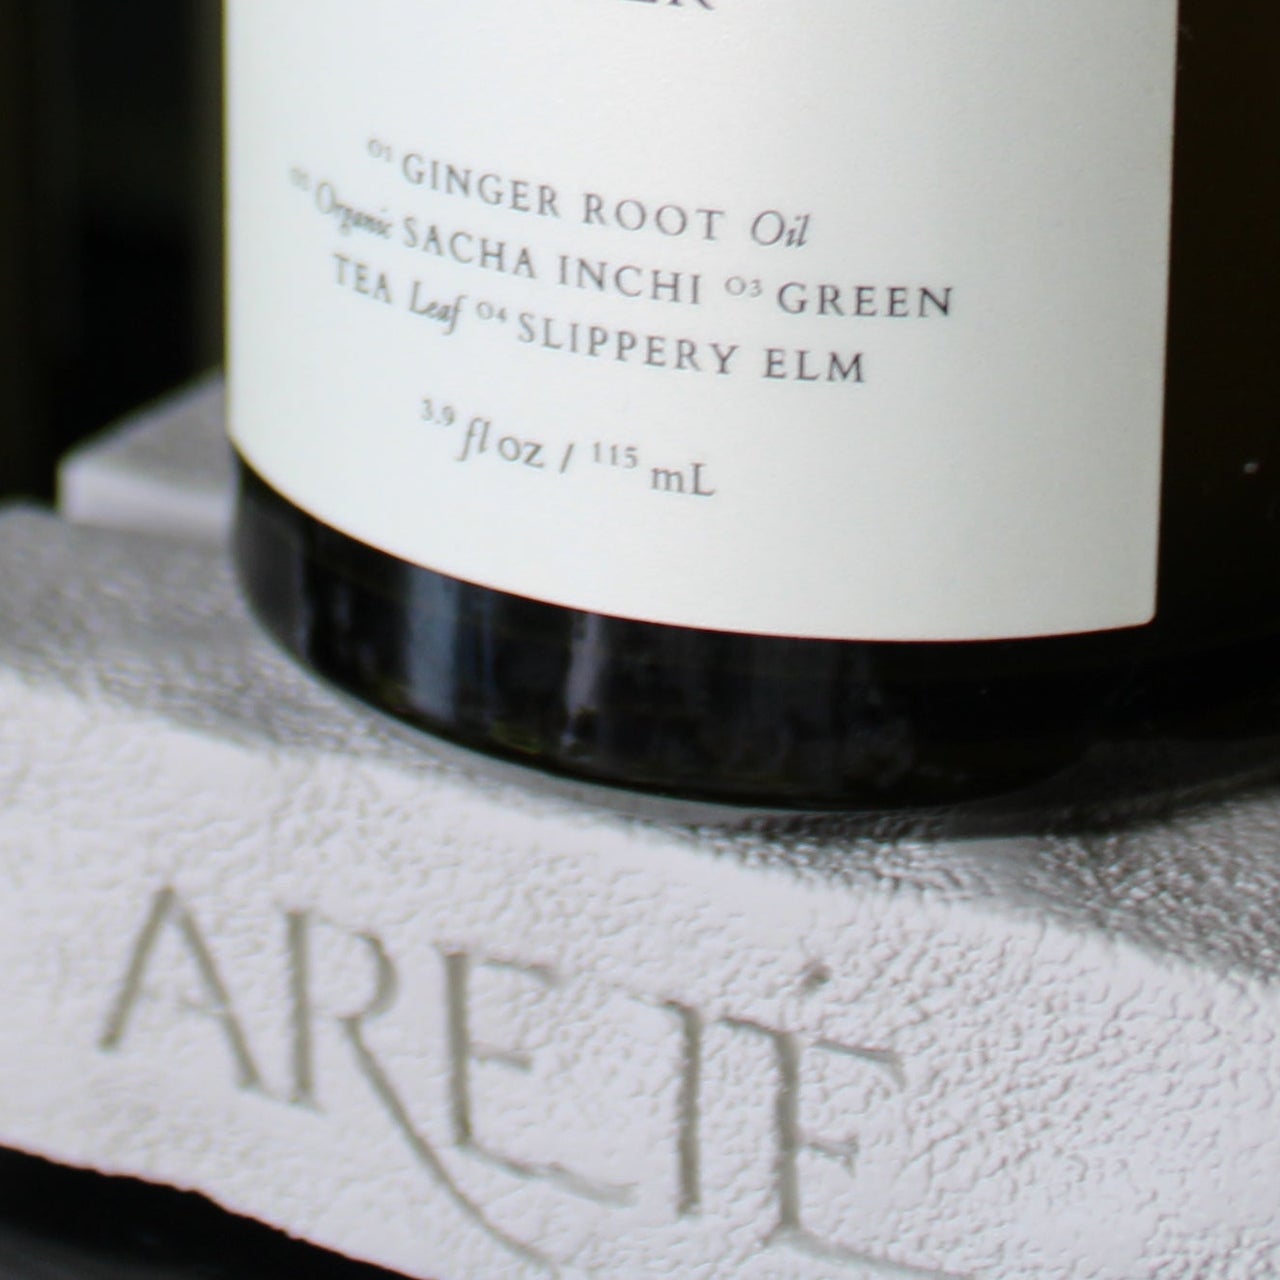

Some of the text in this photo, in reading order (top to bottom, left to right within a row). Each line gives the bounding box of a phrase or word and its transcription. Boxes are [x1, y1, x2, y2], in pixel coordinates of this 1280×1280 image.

[402, 151, 560, 218] GINGER
[583, 193, 726, 242] ROOT
[750, 209, 813, 249] Oil
[331, 251, 393, 306] TEA
[409, 280, 470, 336] Leaf
[518, 312, 740, 377] SLIPPERY
[762, 349, 867, 385] ELM
[402, 215, 538, 280] SACHA
[557, 254, 704, 306] INCHI
[776, 281, 955, 319] GREEN
[420, 397, 456, 427] 3.9
[592, 441, 638, 470] 115
[650, 461, 716, 498] mL
